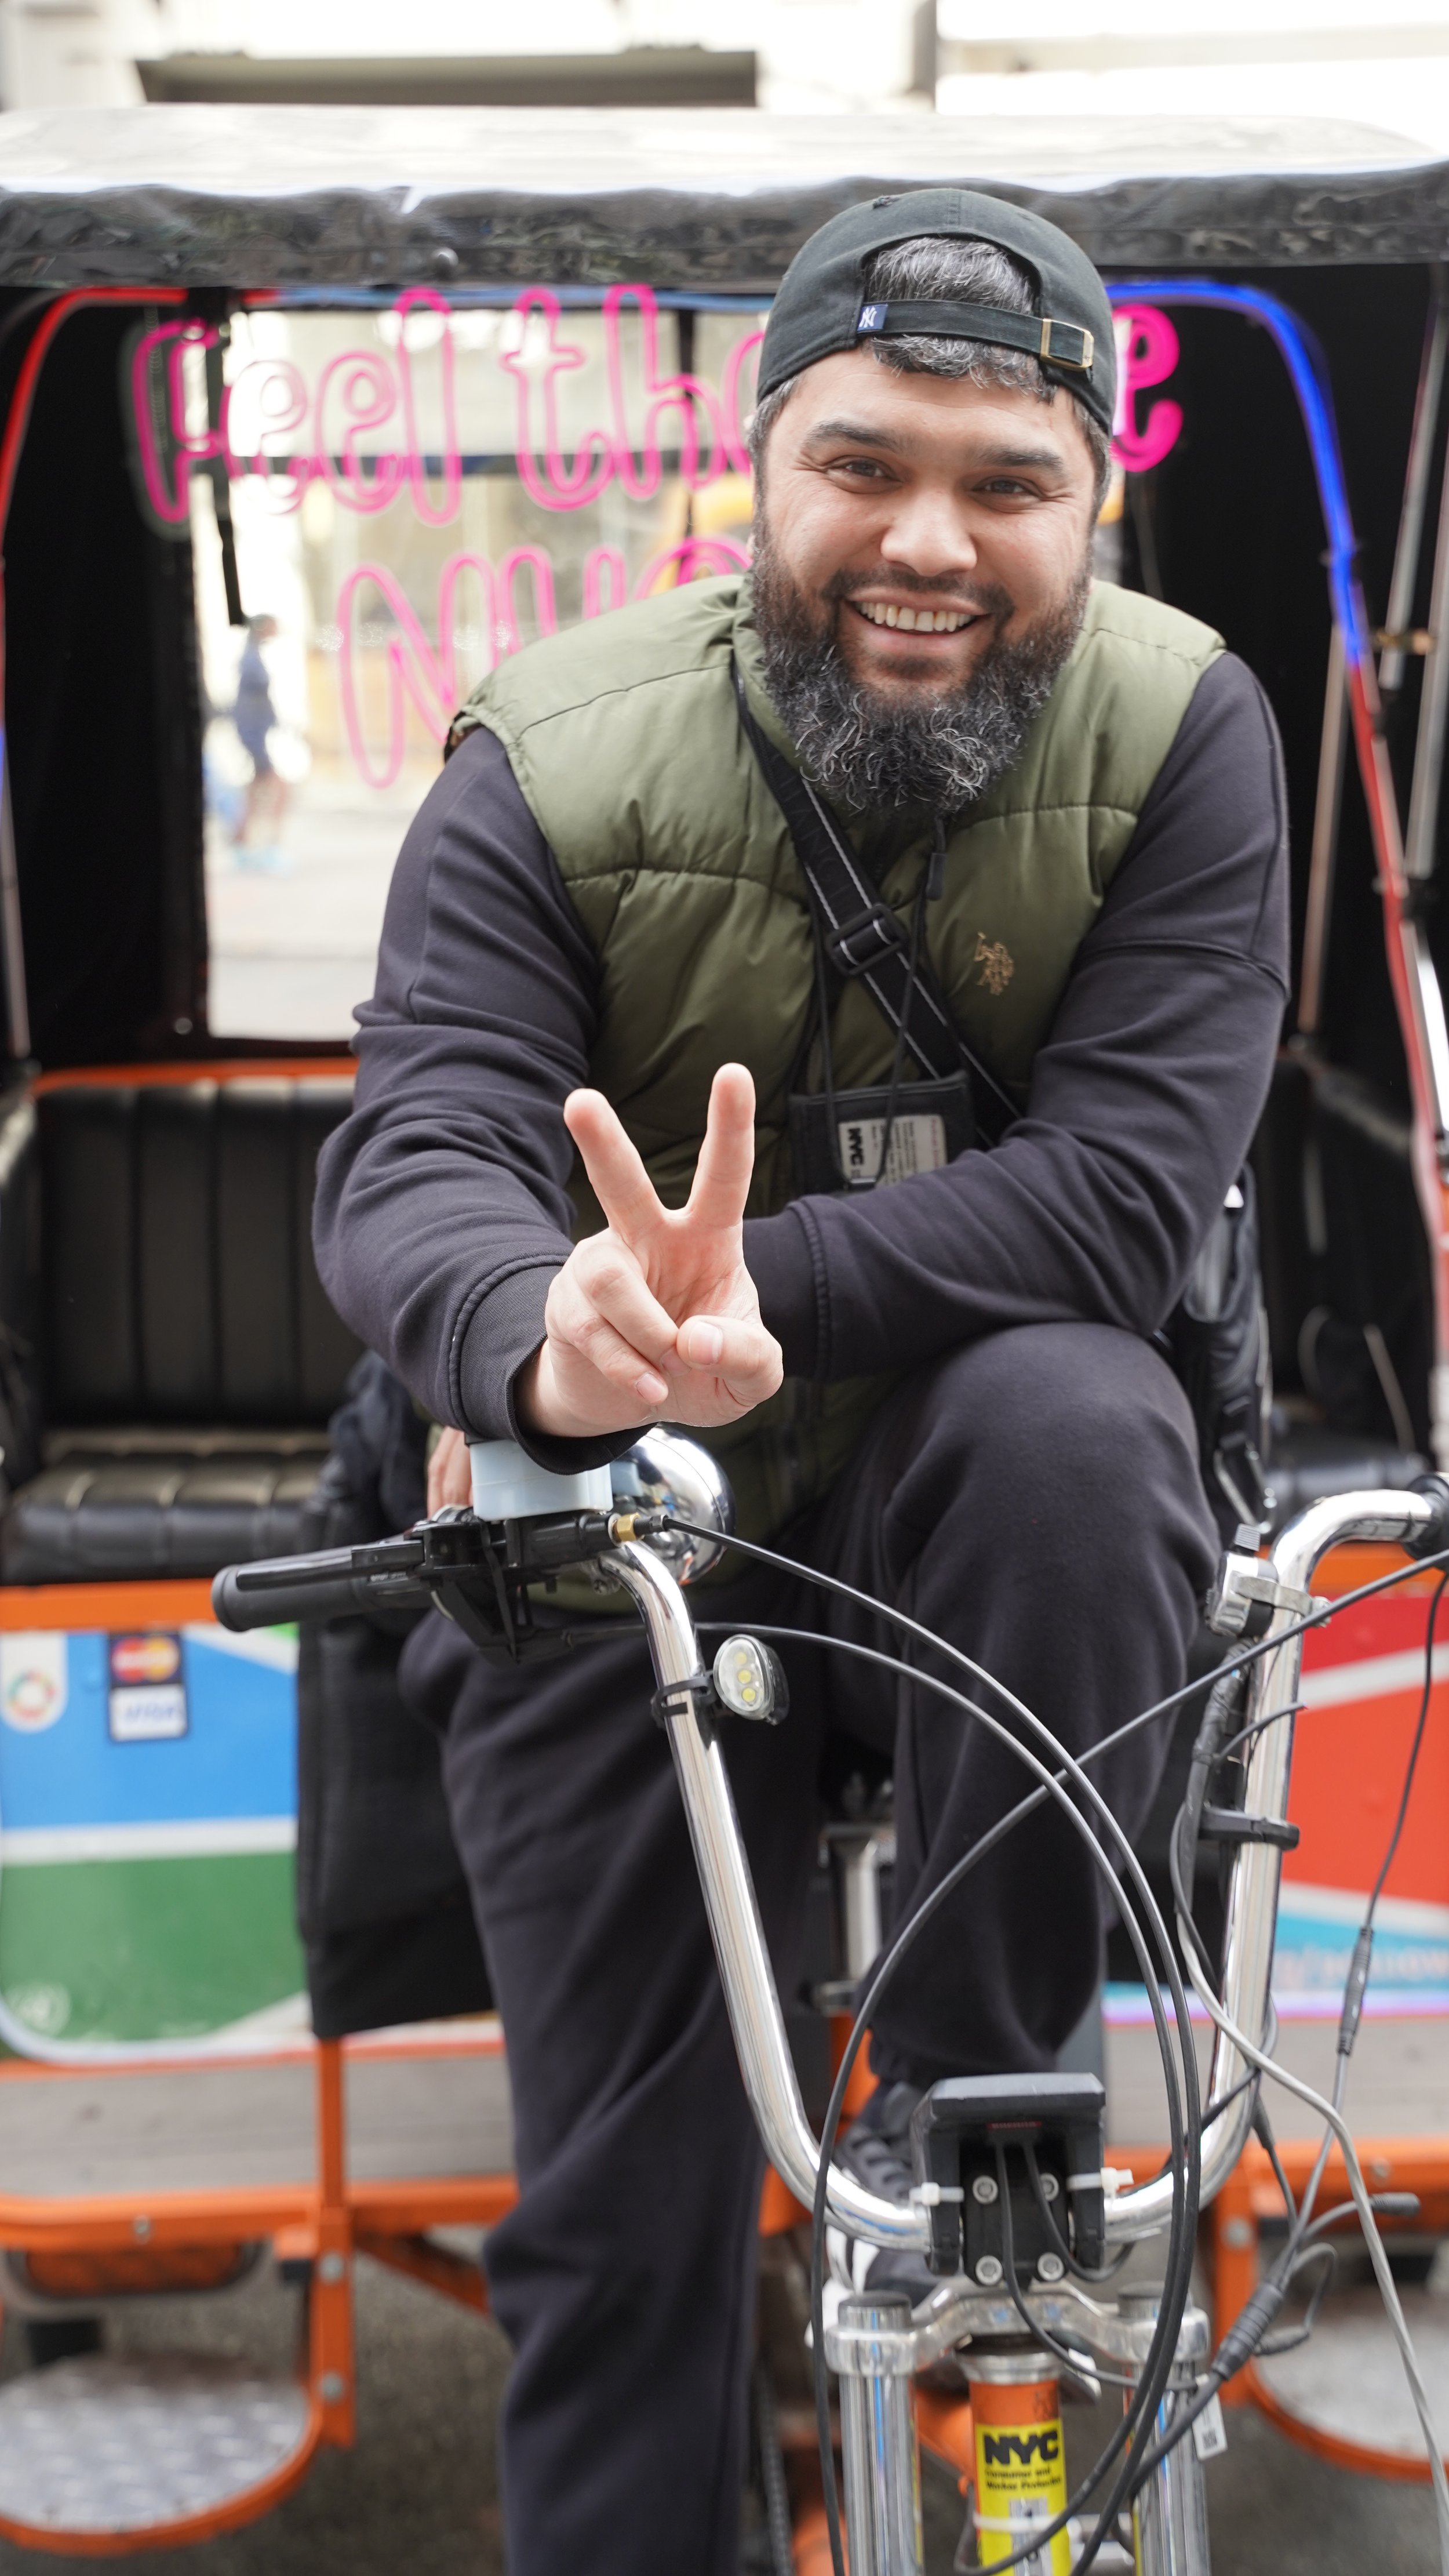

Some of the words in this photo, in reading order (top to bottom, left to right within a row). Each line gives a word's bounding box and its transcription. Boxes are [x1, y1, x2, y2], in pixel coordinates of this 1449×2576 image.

[858, 306, 877, 328] NY
[132, 287, 461, 526] Feel
[847, 1127, 865, 1166] NYC
[984, 2429, 1059, 2465] NYC
[986, 2469, 1031, 2479] Consumer
[1036, 2467, 1051, 2476] and
